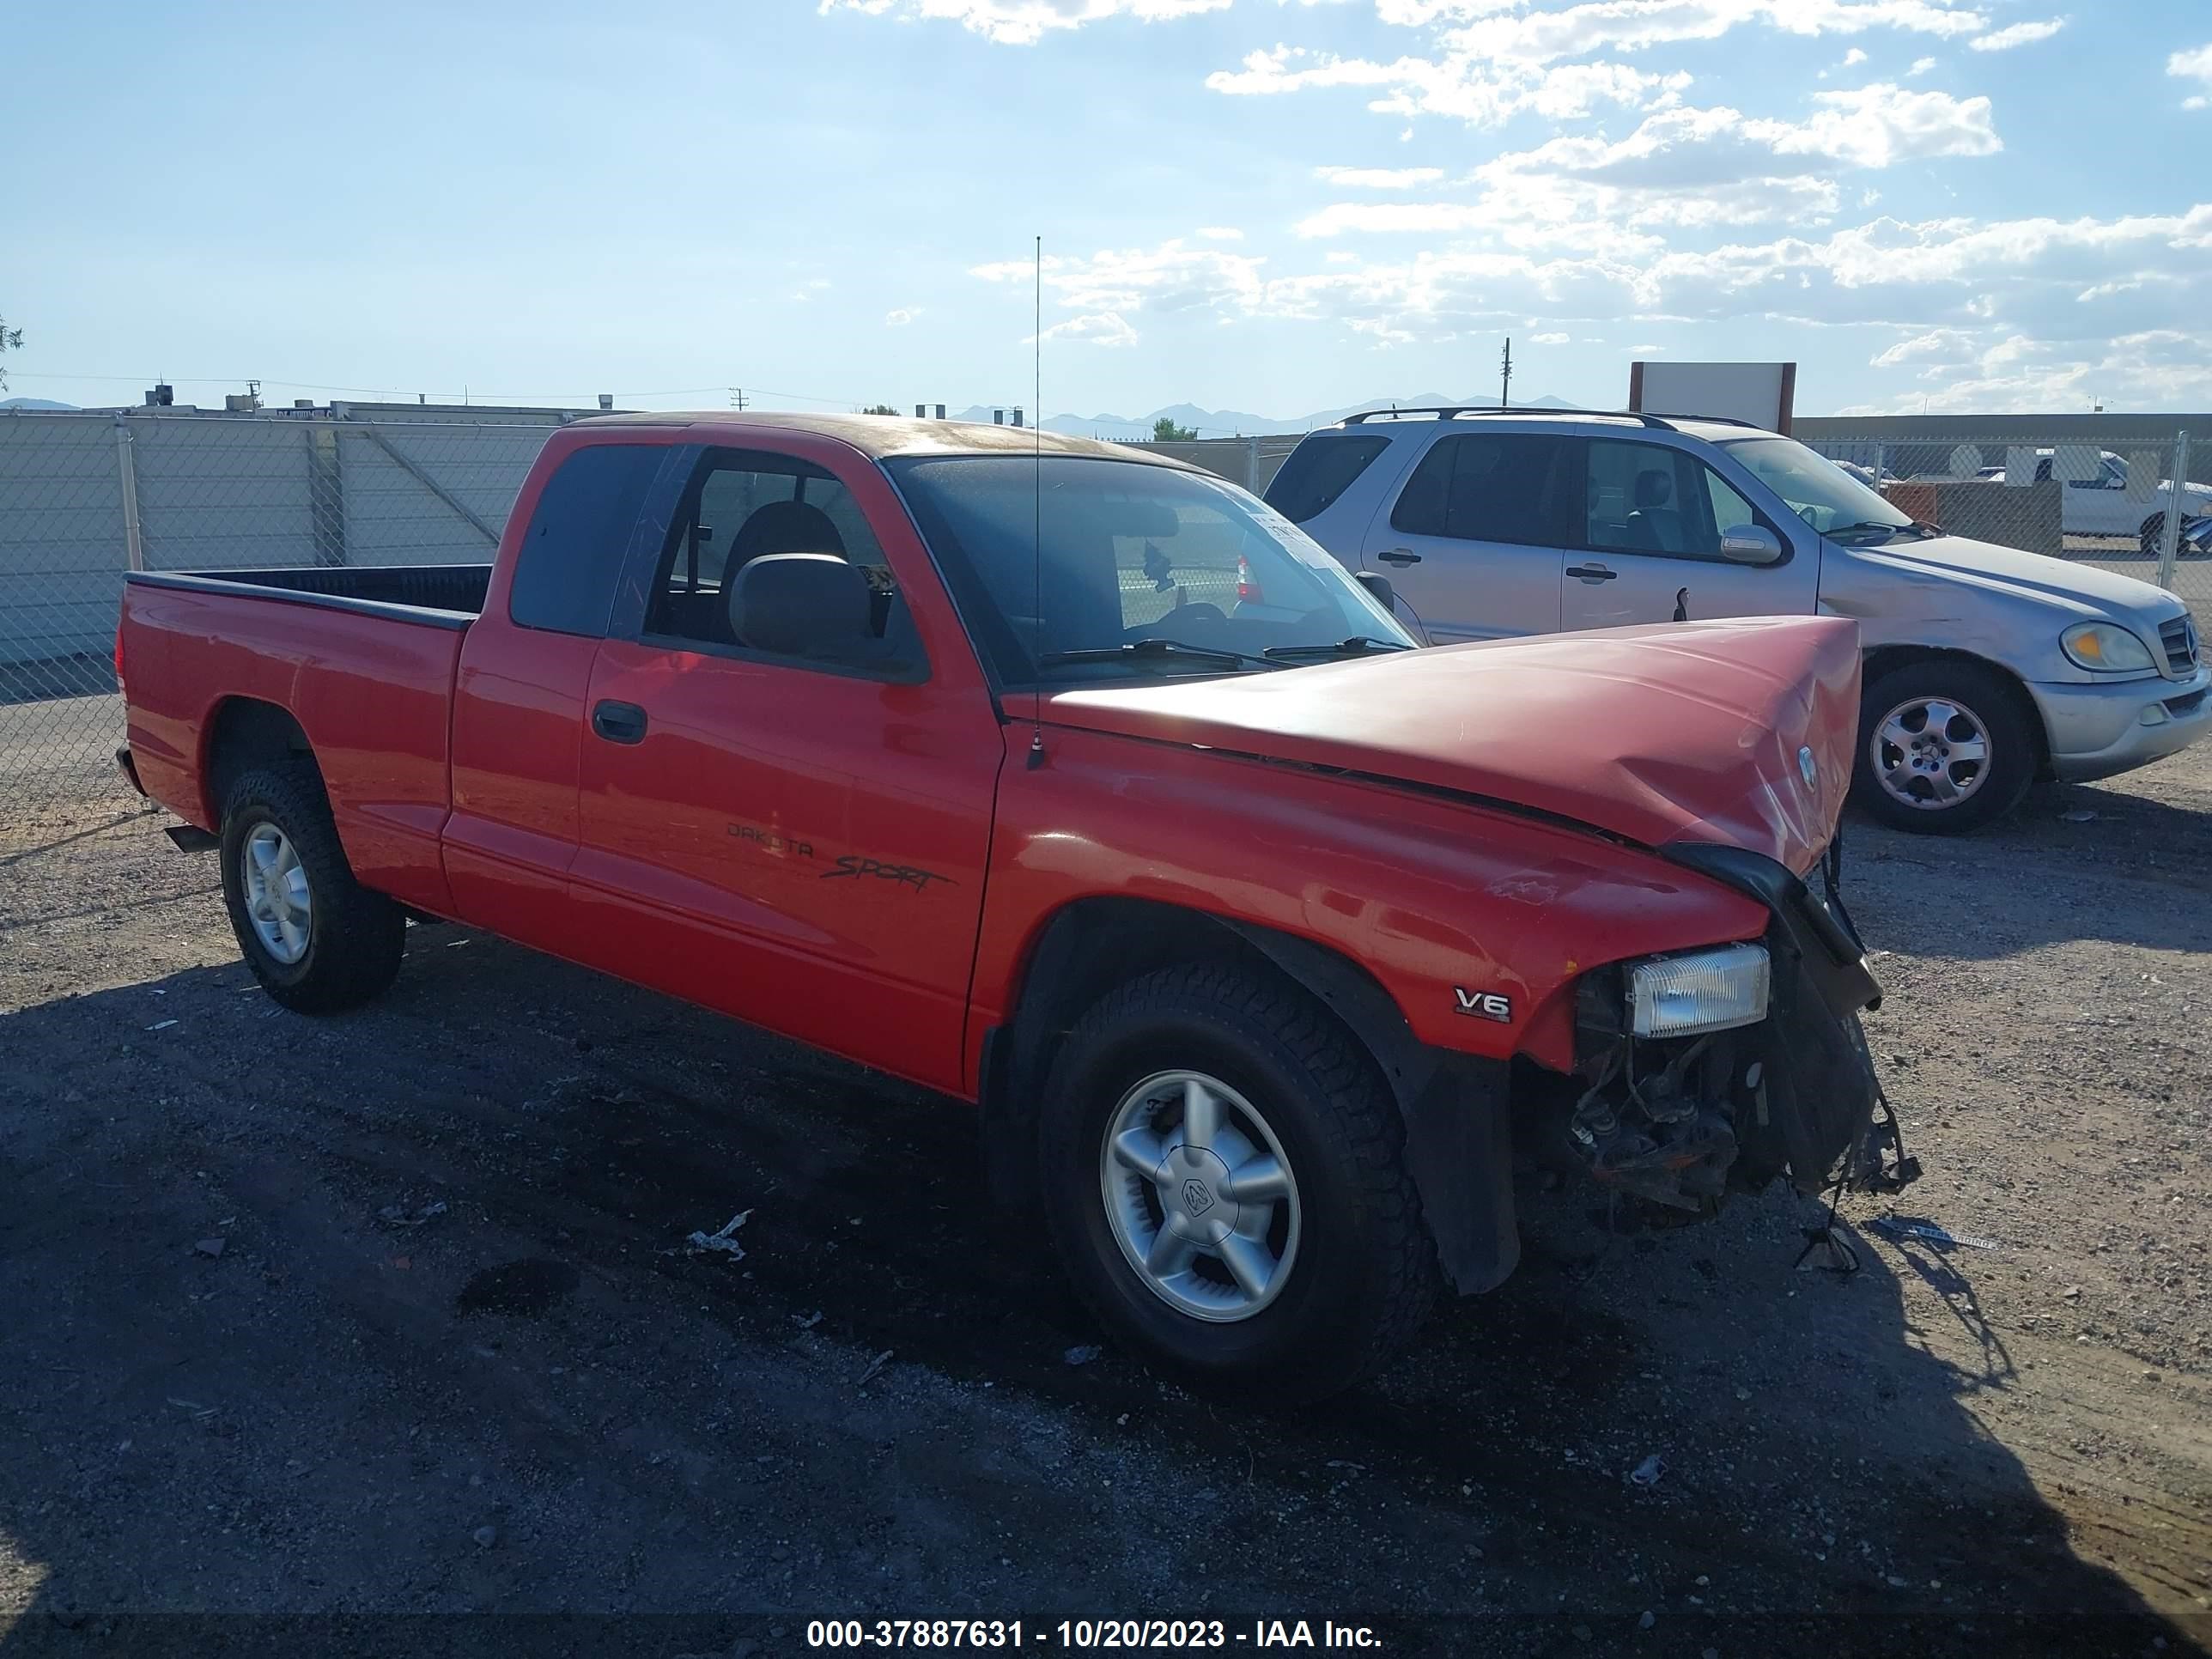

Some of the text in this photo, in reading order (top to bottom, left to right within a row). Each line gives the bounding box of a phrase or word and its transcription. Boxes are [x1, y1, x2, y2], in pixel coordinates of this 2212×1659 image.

[727, 822, 960, 894] DAKOTA SPORT
[1455, 988, 1510, 1015] V6
